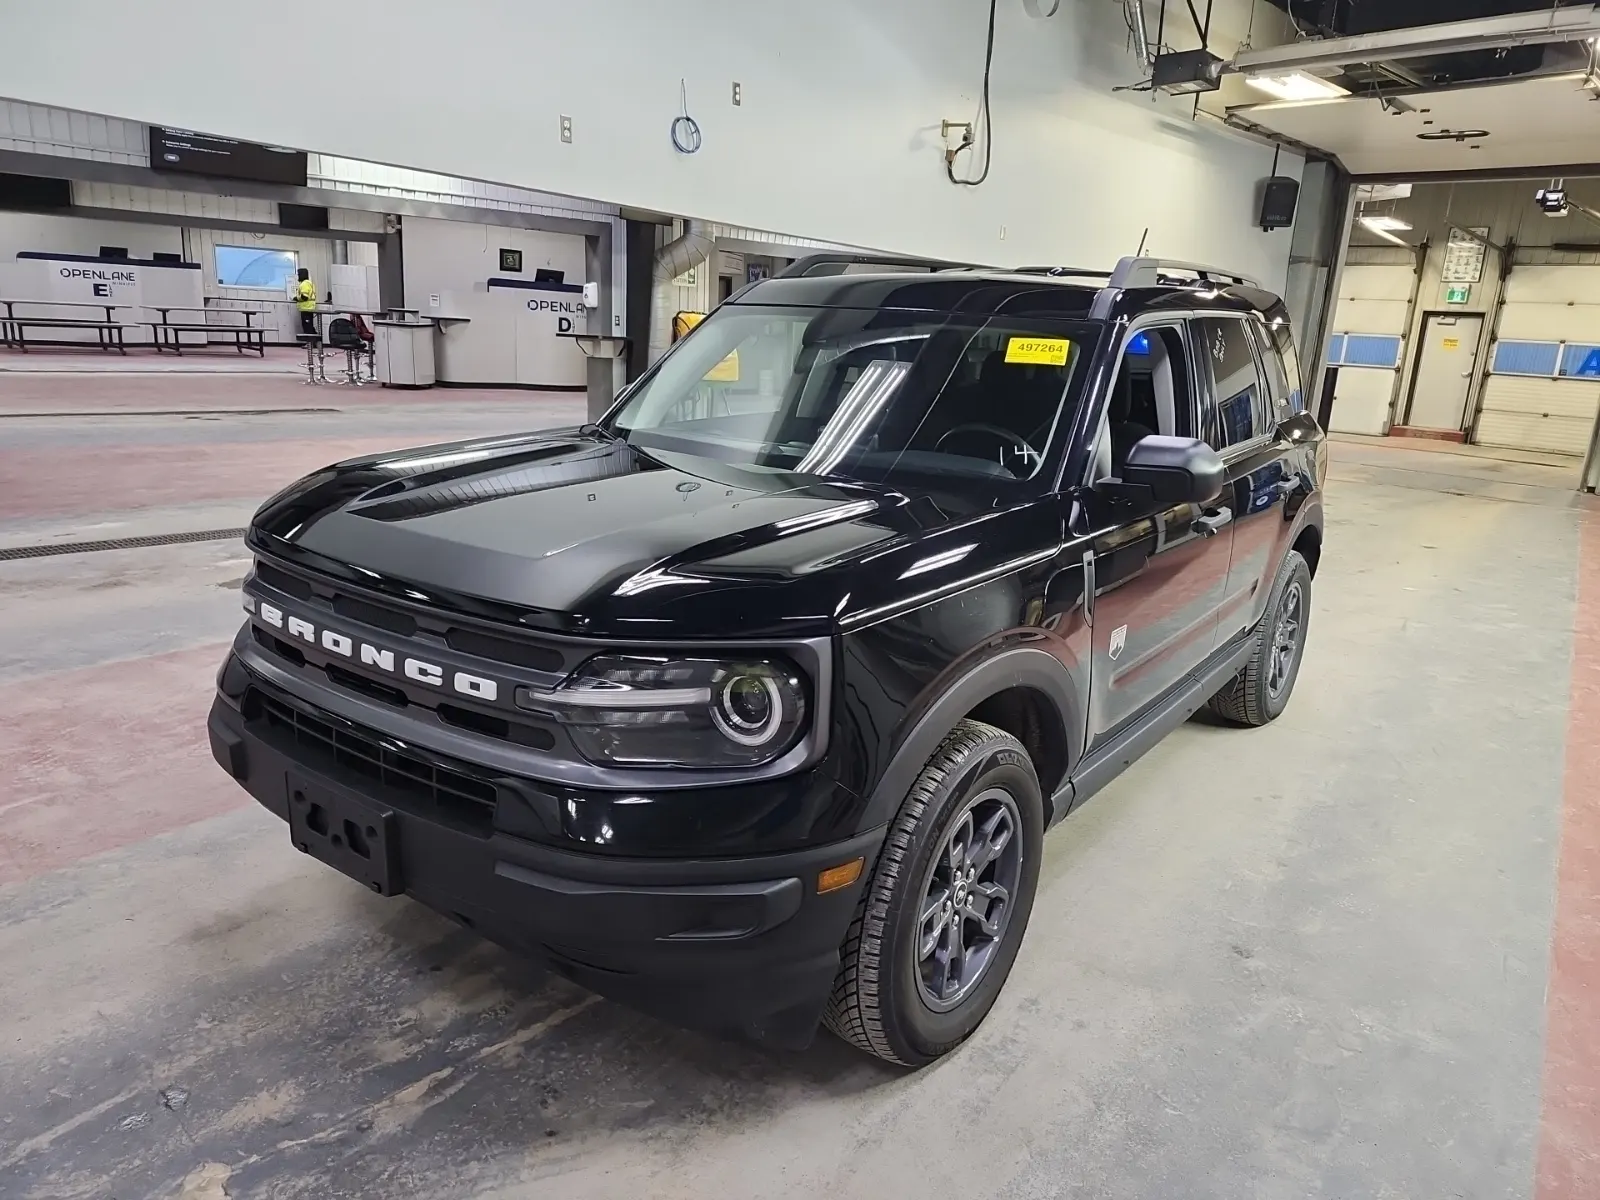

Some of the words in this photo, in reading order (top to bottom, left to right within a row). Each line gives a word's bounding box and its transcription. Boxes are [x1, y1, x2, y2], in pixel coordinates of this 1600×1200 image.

[60, 268, 136, 282] OPENLANE
[93, 283, 109, 297] E
[527, 299, 588, 314] OPENLAN
[558, 316, 572, 333] D
[1017, 343, 1064, 353] 497264
[260, 602, 498, 701] BRONCO
